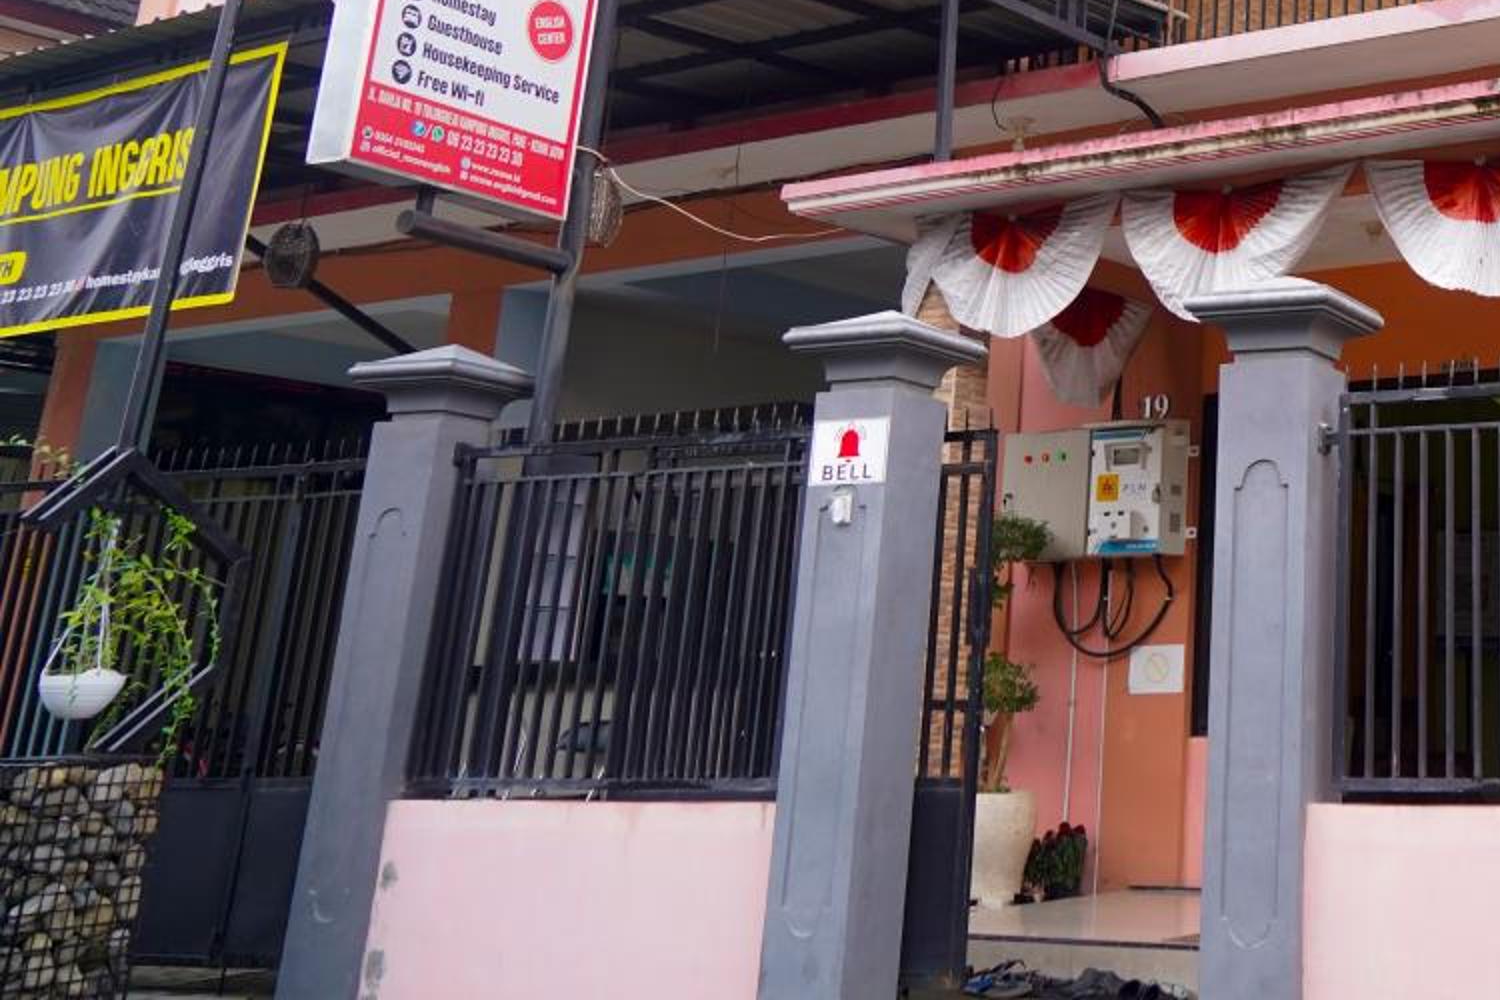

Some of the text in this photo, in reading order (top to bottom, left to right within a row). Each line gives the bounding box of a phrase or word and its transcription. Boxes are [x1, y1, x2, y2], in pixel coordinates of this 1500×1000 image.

[427, 14, 503, 56] Guesthouse
[416, 69, 449, 95] Free
[422, 41, 560, 105] Housekeeping Service
[87, 127, 195, 199] INGGRIS
[1143, 393, 1169, 419] 19
[821, 464, 872, 481] BELL
